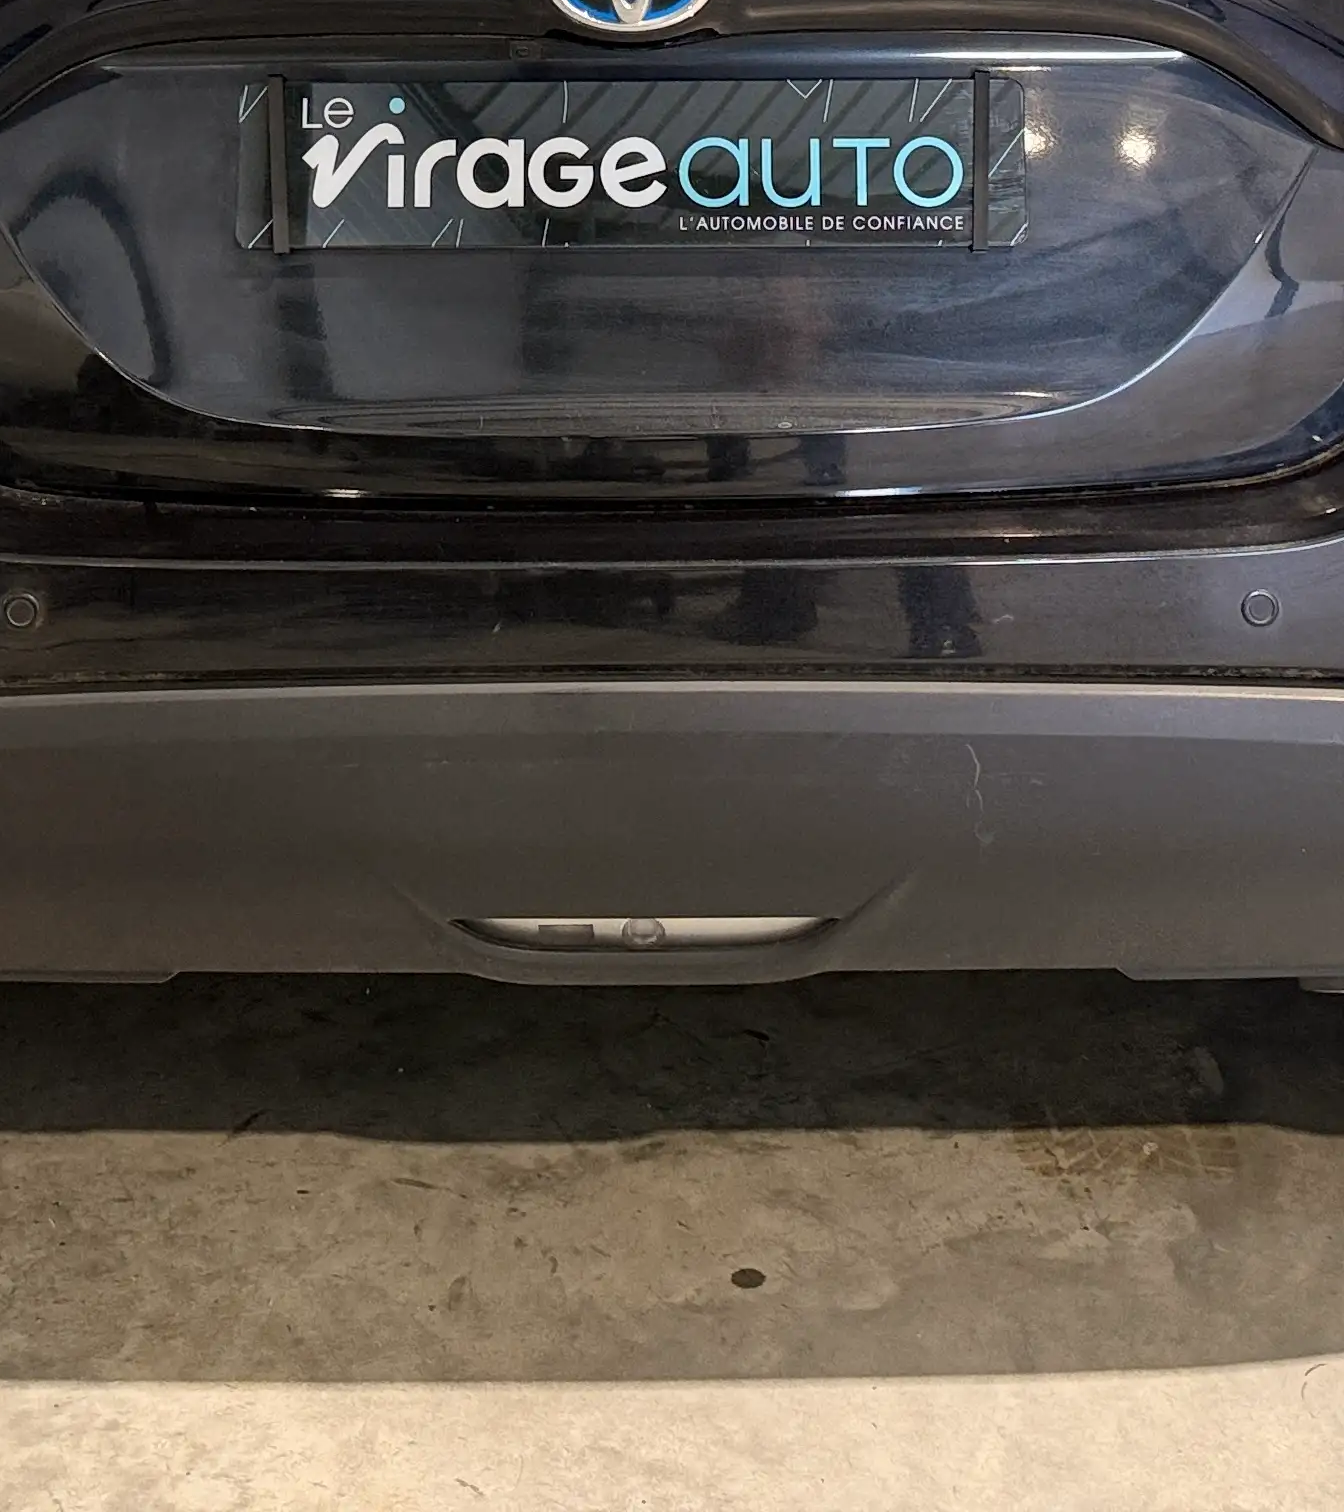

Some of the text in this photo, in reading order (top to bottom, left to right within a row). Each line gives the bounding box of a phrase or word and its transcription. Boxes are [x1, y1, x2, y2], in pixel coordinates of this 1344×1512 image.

[678, 215, 965, 232] L'AUTOMOBILE DE CONFIANCE
